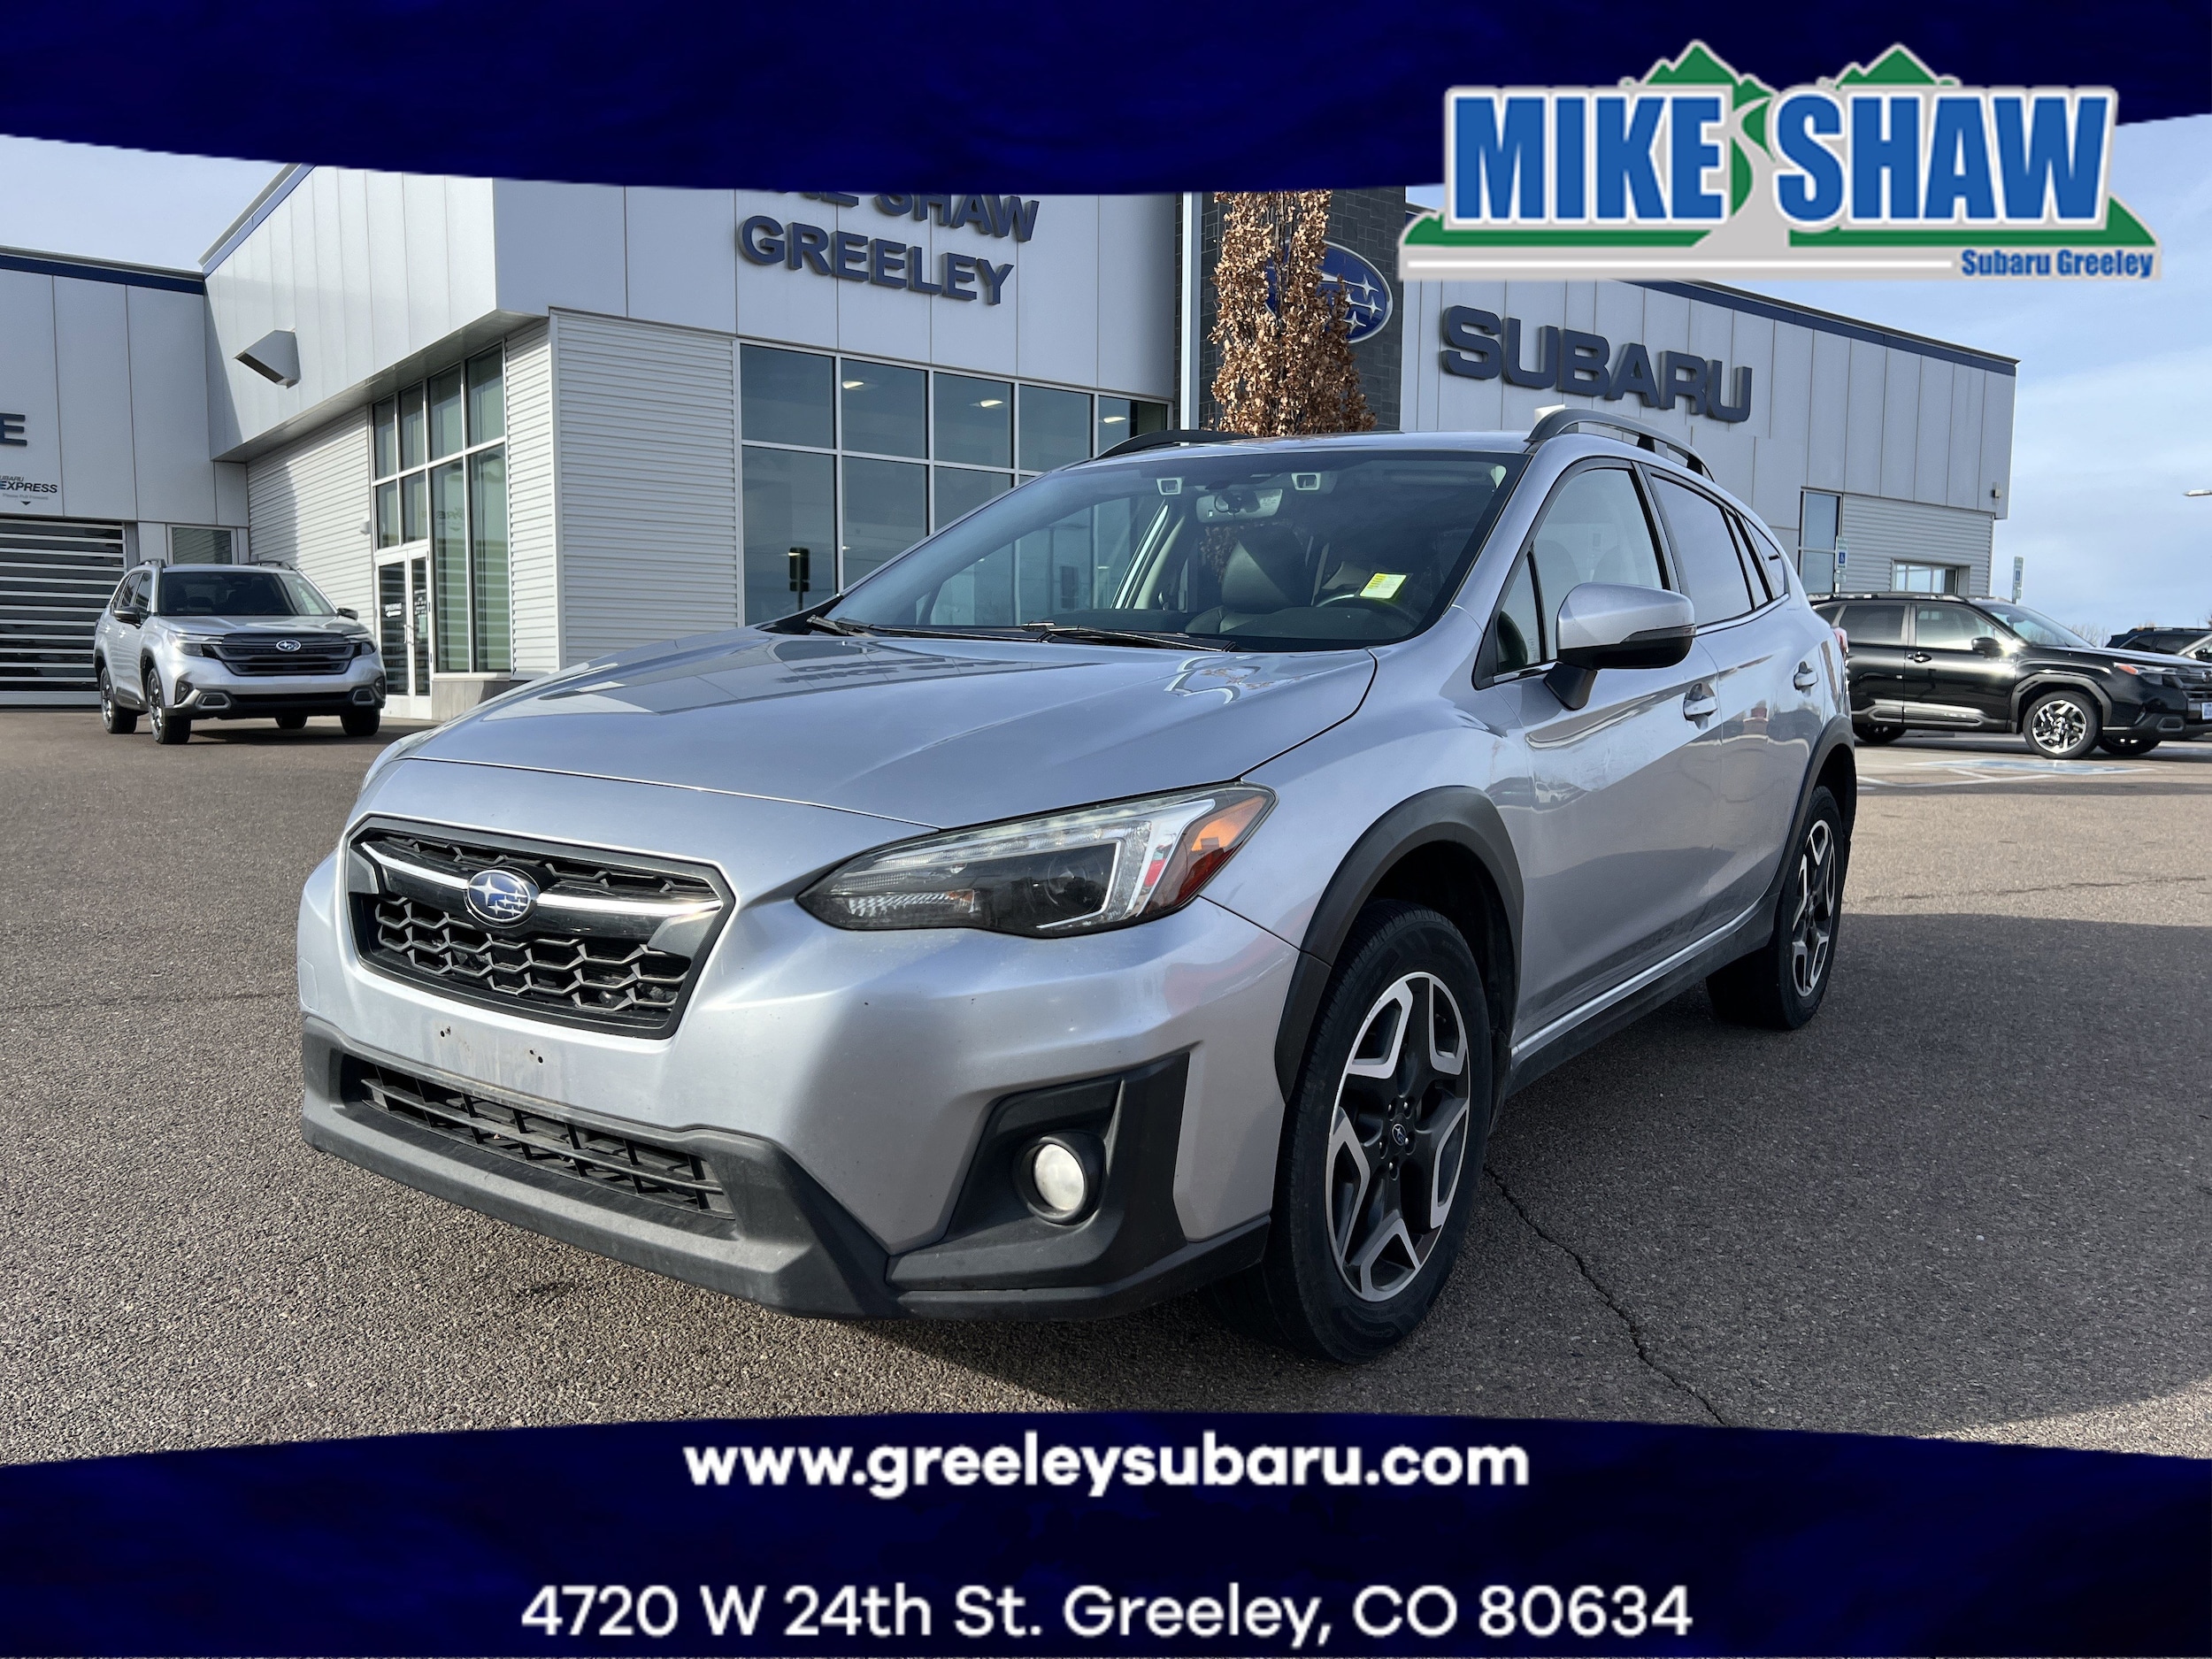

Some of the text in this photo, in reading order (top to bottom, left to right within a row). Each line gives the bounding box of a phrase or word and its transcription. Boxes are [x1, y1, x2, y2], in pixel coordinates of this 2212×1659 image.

[737, 215, 1014, 305] GREELEY
[1440, 304, 1753, 423] SUBARU
[0, 480, 58, 493] EXPRESS
